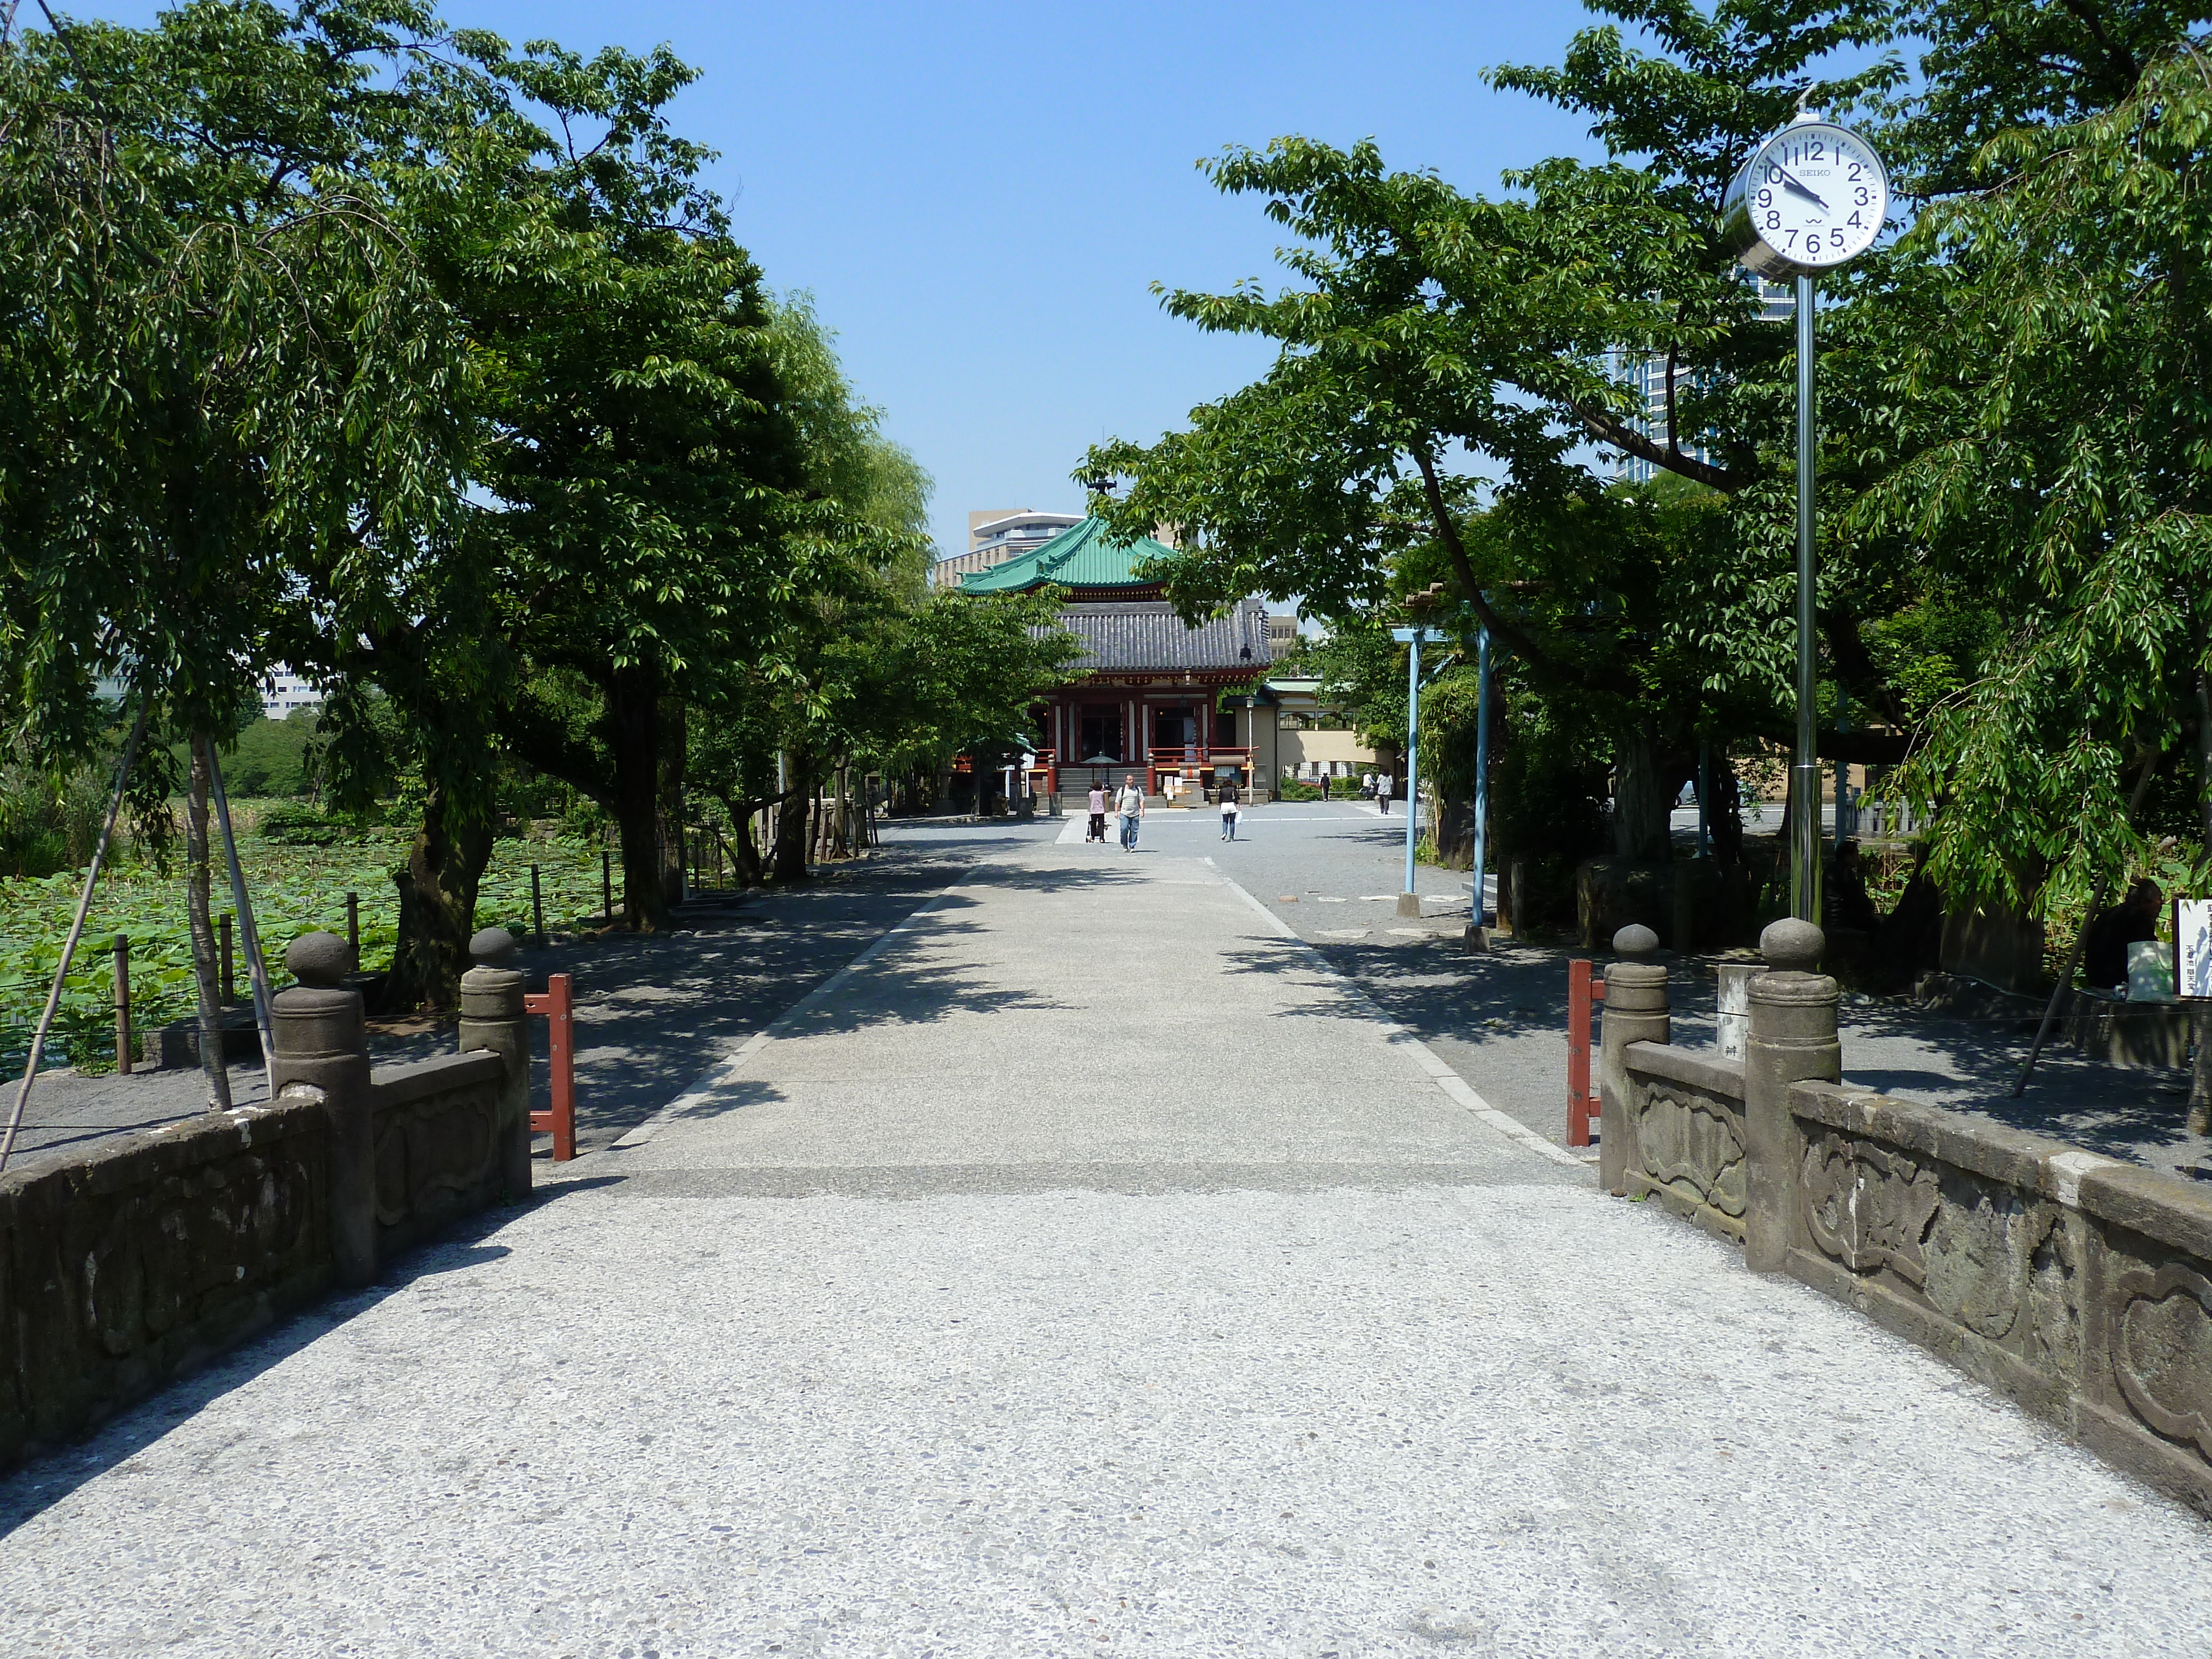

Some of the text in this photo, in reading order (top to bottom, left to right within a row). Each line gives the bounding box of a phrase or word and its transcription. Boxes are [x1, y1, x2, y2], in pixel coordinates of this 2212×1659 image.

[1784, 147, 1798, 166] 11
[1804, 141, 1824, 161] 12
[1835, 146, 1839, 166] 1
[1764, 165, 1783, 184] 10
[1848, 163, 1861, 182] 2
[1757, 189, 1772, 208] 9
[1854, 186, 1869, 206] 3
[1766, 210, 1781, 229] 8
[1846, 210, 1862, 229] 4
[1785, 229, 1799, 248] 7
[1806, 234, 1820, 253] 6
[1830, 228, 1844, 247] 5
